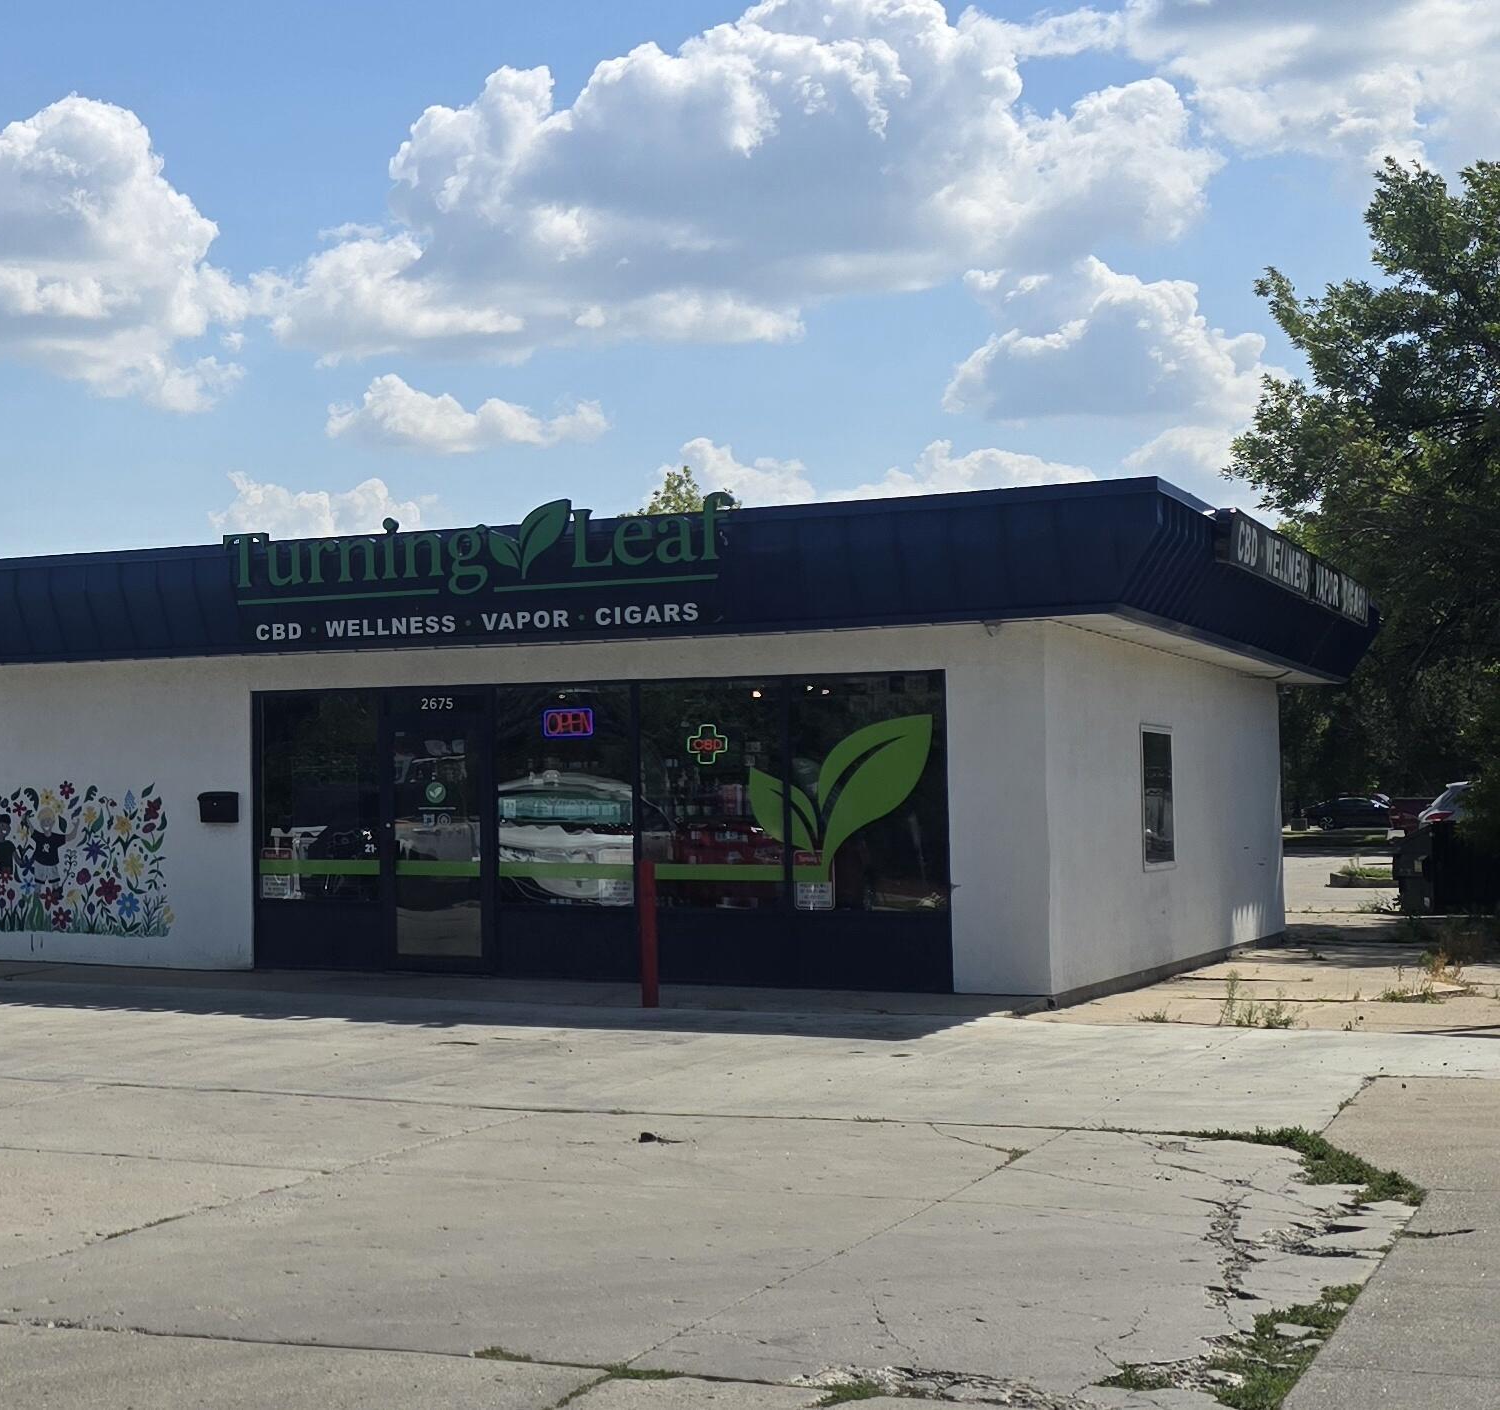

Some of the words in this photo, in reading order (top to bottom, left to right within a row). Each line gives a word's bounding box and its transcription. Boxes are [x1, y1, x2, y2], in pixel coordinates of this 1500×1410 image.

[223, 517, 488, 595] Turning
[570, 491, 735, 568] Leaf
[1237, 520, 1258, 567] CBD
[1265, 535, 1310, 593] WELLNESS
[255, 624, 302, 642] CBD
[325, 615, 457, 638] WELLNESS
[481, 609, 569, 632] VAPOR
[594, 602, 699, 627] CIGARS
[420, 697, 454, 710] 2675
[547, 711, 592, 734] OPEN
[692, 738, 722, 751] CBD
